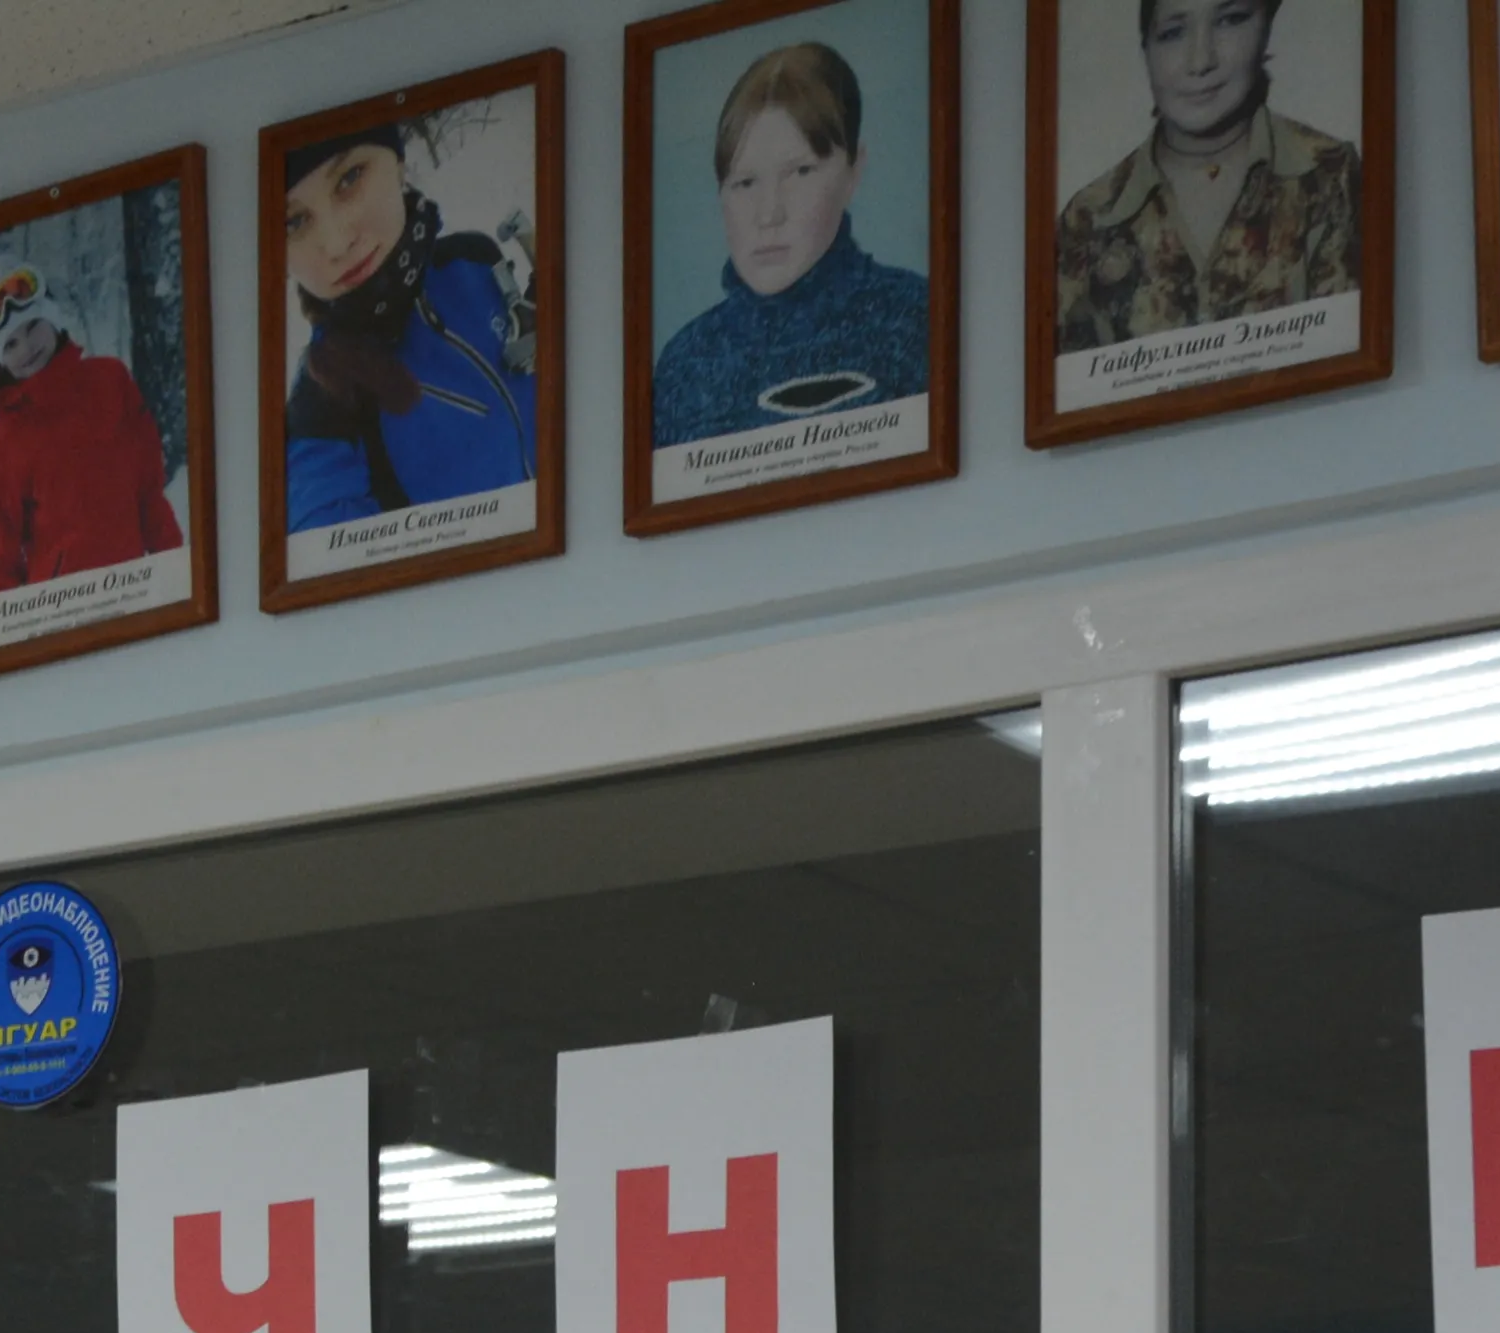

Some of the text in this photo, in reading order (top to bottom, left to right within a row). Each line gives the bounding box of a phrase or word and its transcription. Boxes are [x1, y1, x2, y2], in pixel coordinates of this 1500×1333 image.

[1088, 309, 1327, 378] Гайфуллина Эльвира
[683, 409, 901, 471] Маникаева Надежда
[328, 499, 500, 550] Имаева Светлана
[102, 565, 153, 590] Ольга
